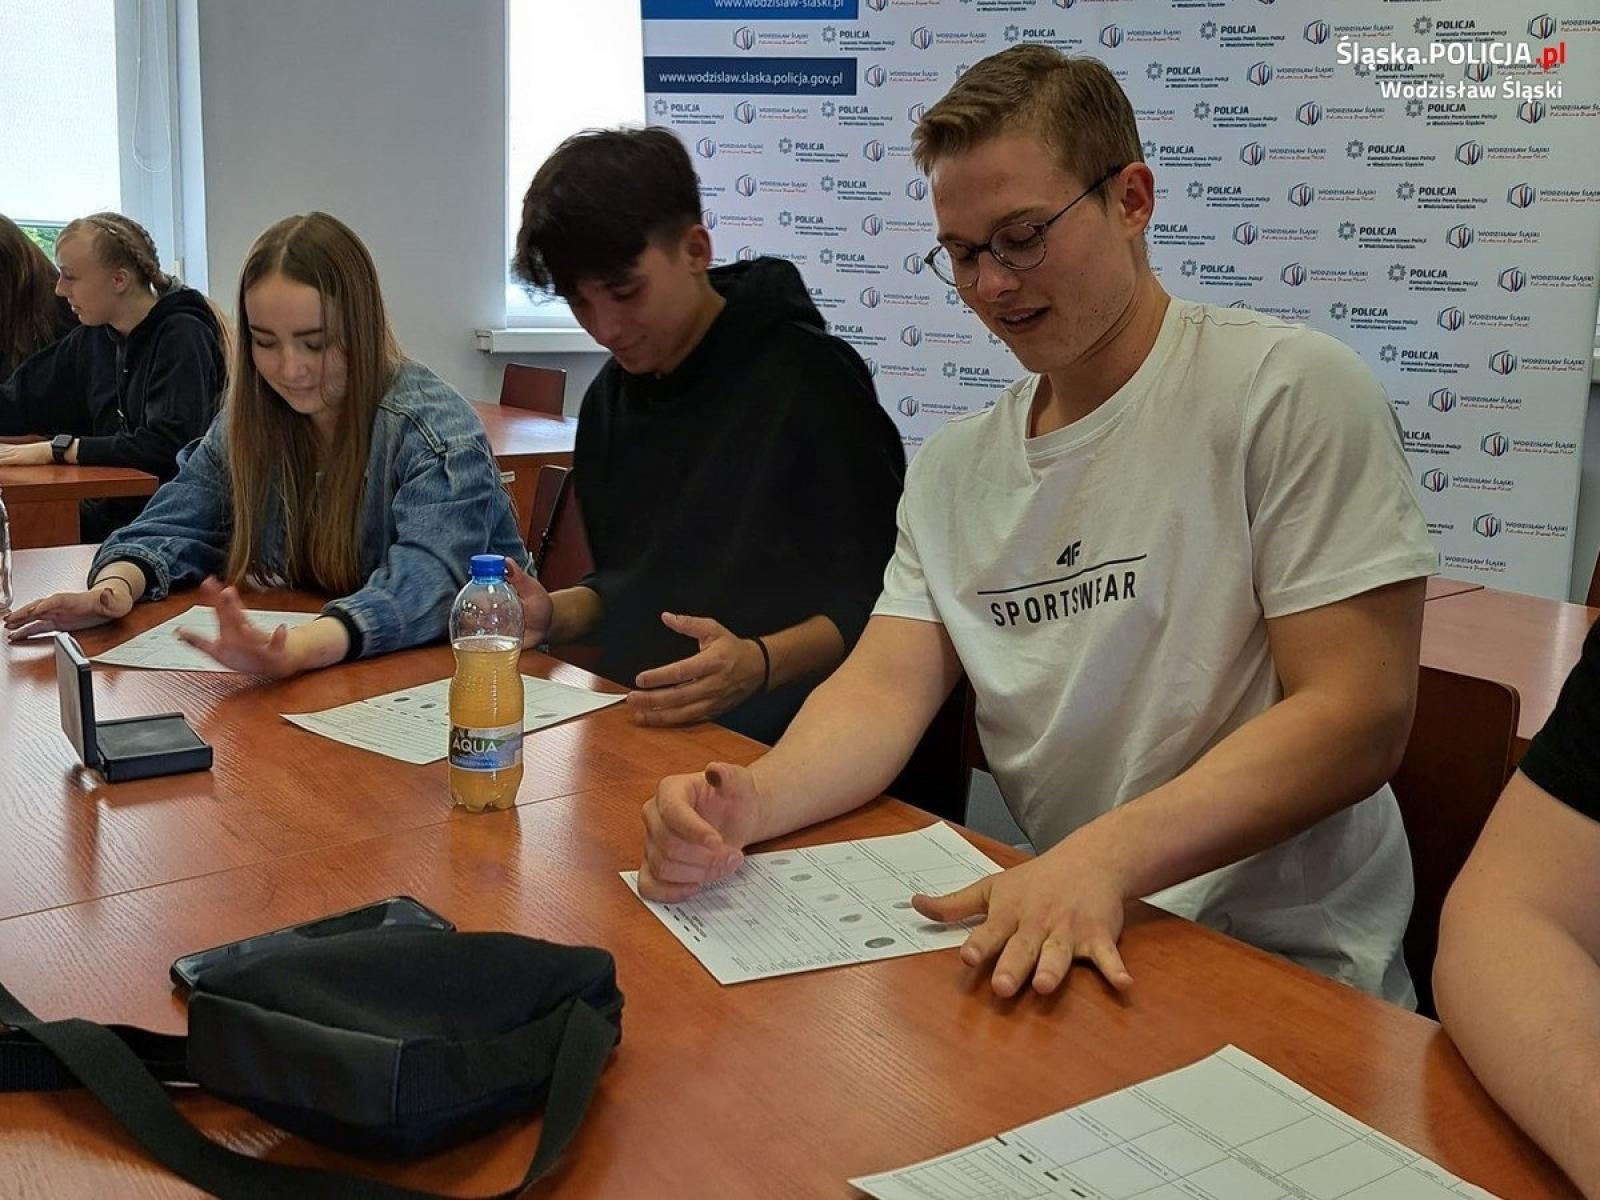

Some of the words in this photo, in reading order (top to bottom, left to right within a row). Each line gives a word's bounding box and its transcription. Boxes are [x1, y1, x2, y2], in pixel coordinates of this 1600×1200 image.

[1436, 20, 1475, 29] POLICJA
[1023, 29, 1055, 37] POLICJA
[1221, 25, 1256, 34] POLICJA
[1166, 67, 1200, 75] POLICJA
[1376, 63, 1414, 72] POLICJA
[658, 71, 843, 87] www.wodzislaw.slaska.policja.gov.pl
[1214, 106, 1248, 115] POLICJA
[1427, 103, 1466, 112] POLICJA
[1160, 146, 1194, 154] POLICJA
[1368, 145, 1405, 153] POLICJA
[1207, 186, 1241, 195] POLICJA
[1419, 187, 1456, 196] POLICJA
[1154, 224, 1188, 232] POLICJA
[1360, 227, 1396, 235] POLICJA
[1200, 265, 1235, 273] POLICJA
[1410, 269, 1447, 278] POLICJA
[1352, 308, 1388, 316] POLICJA
[1401, 351, 1439, 359] POLICJA
[960, 367, 990, 375] POLICJA
[1056, 540, 1082, 567] 4F
[990, 571, 1136, 626] SPORTSWEAR
[452, 736, 498, 756] AQUA
